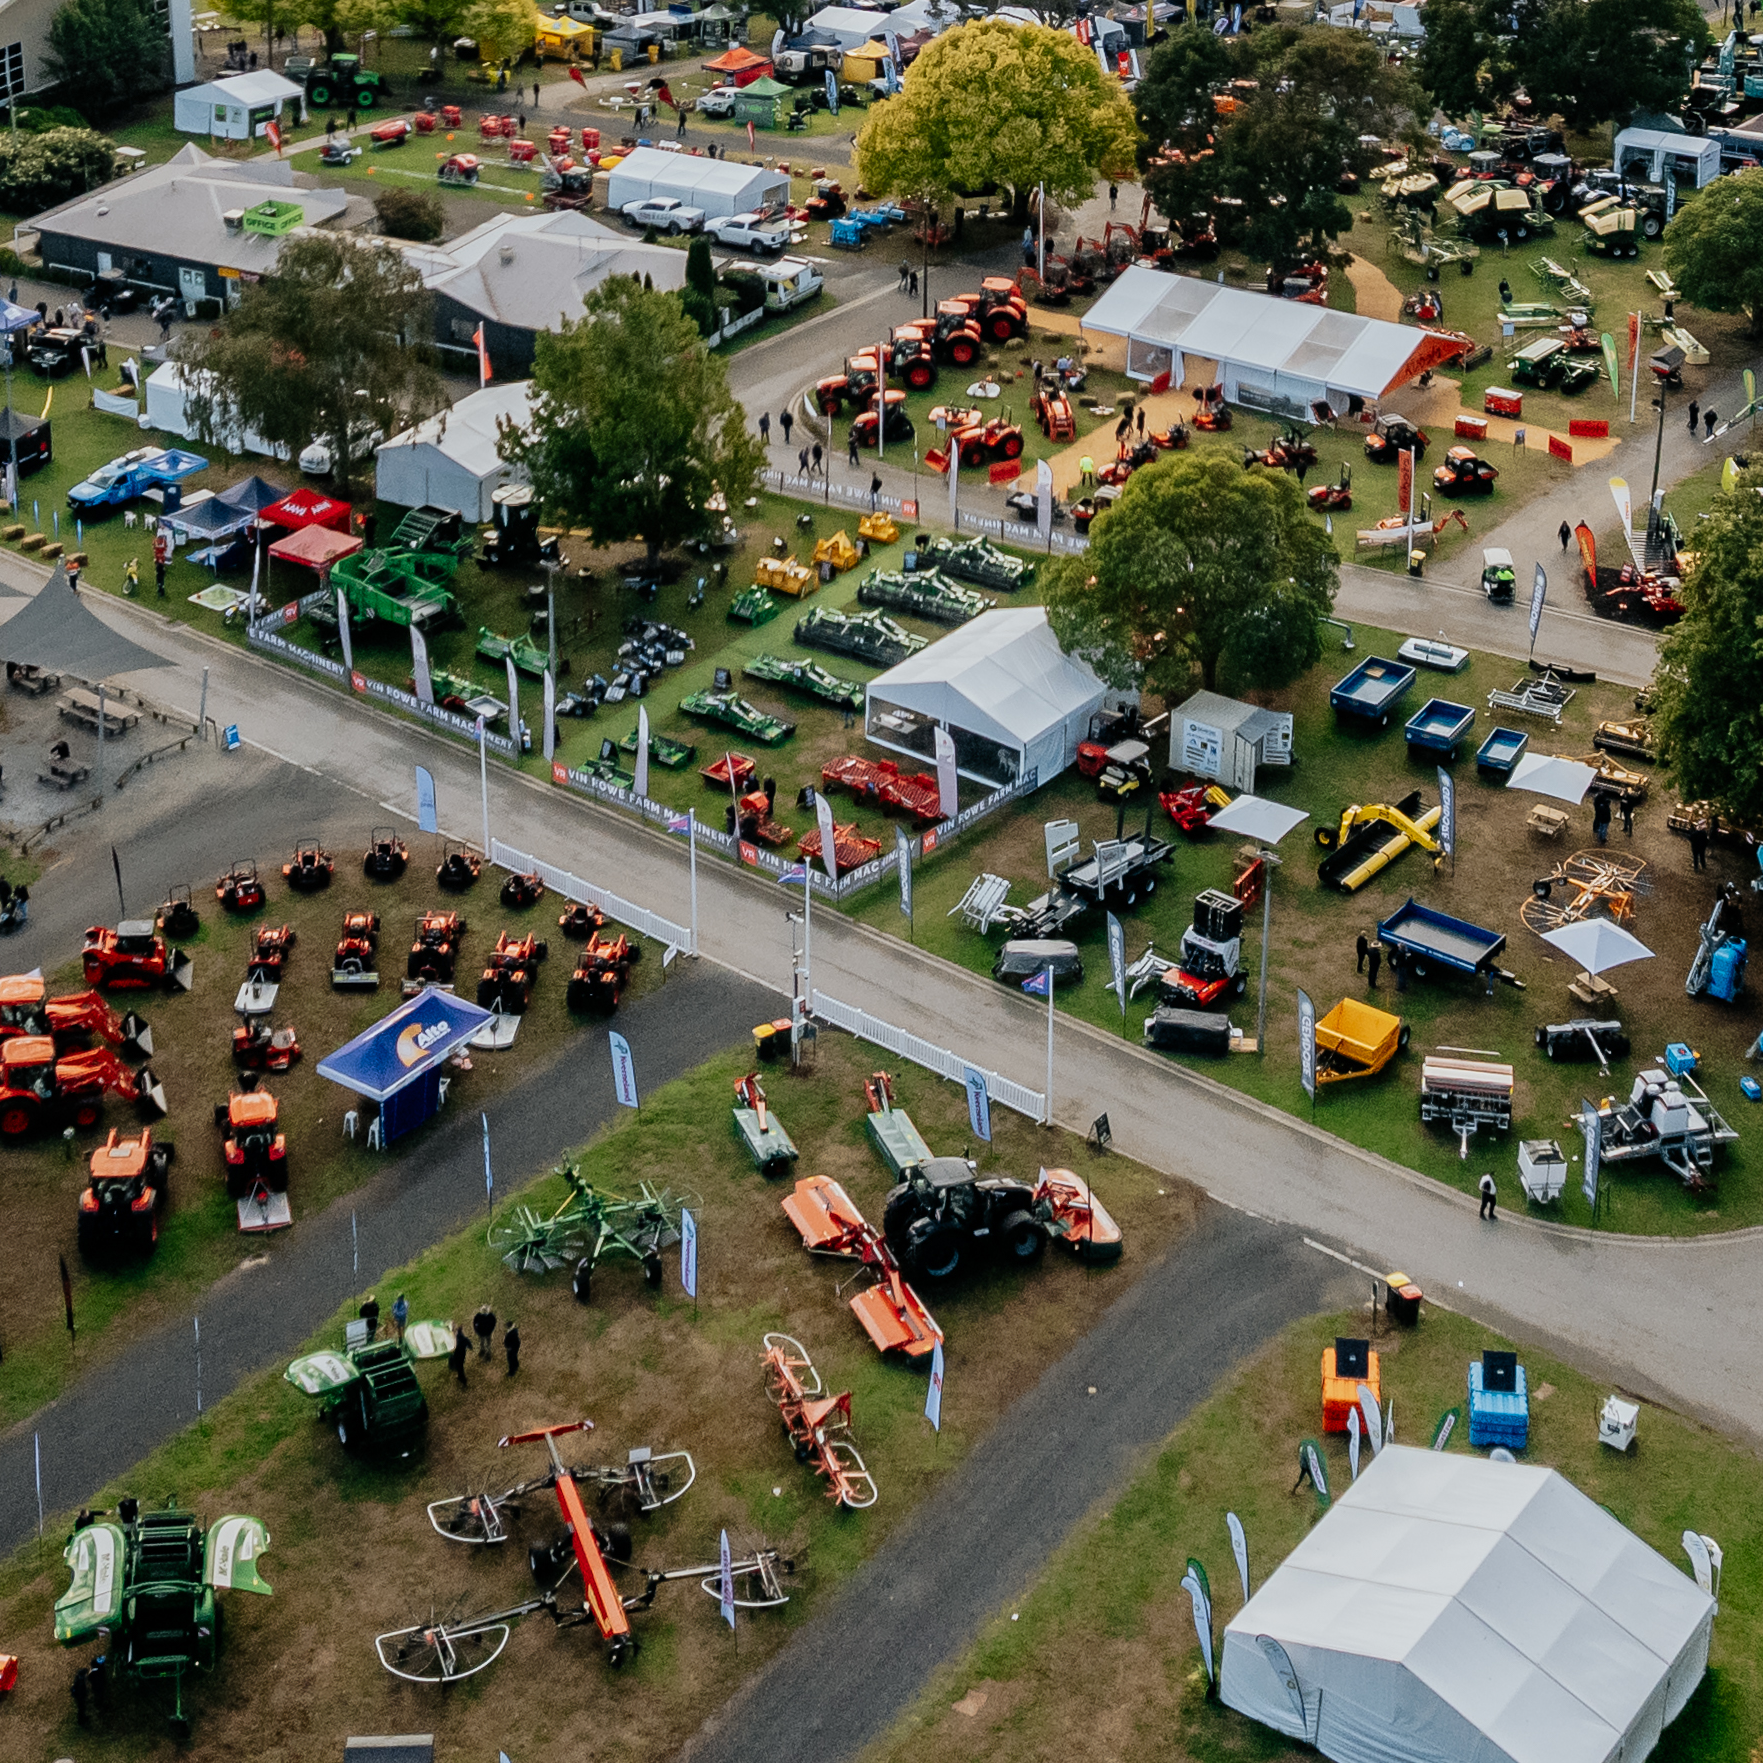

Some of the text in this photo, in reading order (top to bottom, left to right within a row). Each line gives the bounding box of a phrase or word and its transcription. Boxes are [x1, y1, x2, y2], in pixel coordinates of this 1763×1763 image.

[568, 768, 588, 785] VIN
[629, 790, 660, 815] FARM
[936, 818, 956, 837] VIN
[988, 783, 1014, 805] FARM
[741, 846, 756, 861] VR
[757, 849, 779, 868] VIN
[418, 1021, 450, 1046] Alto
[620, 1056, 632, 1102] Kverneland
[974, 1091, 985, 1136] Kverneland
